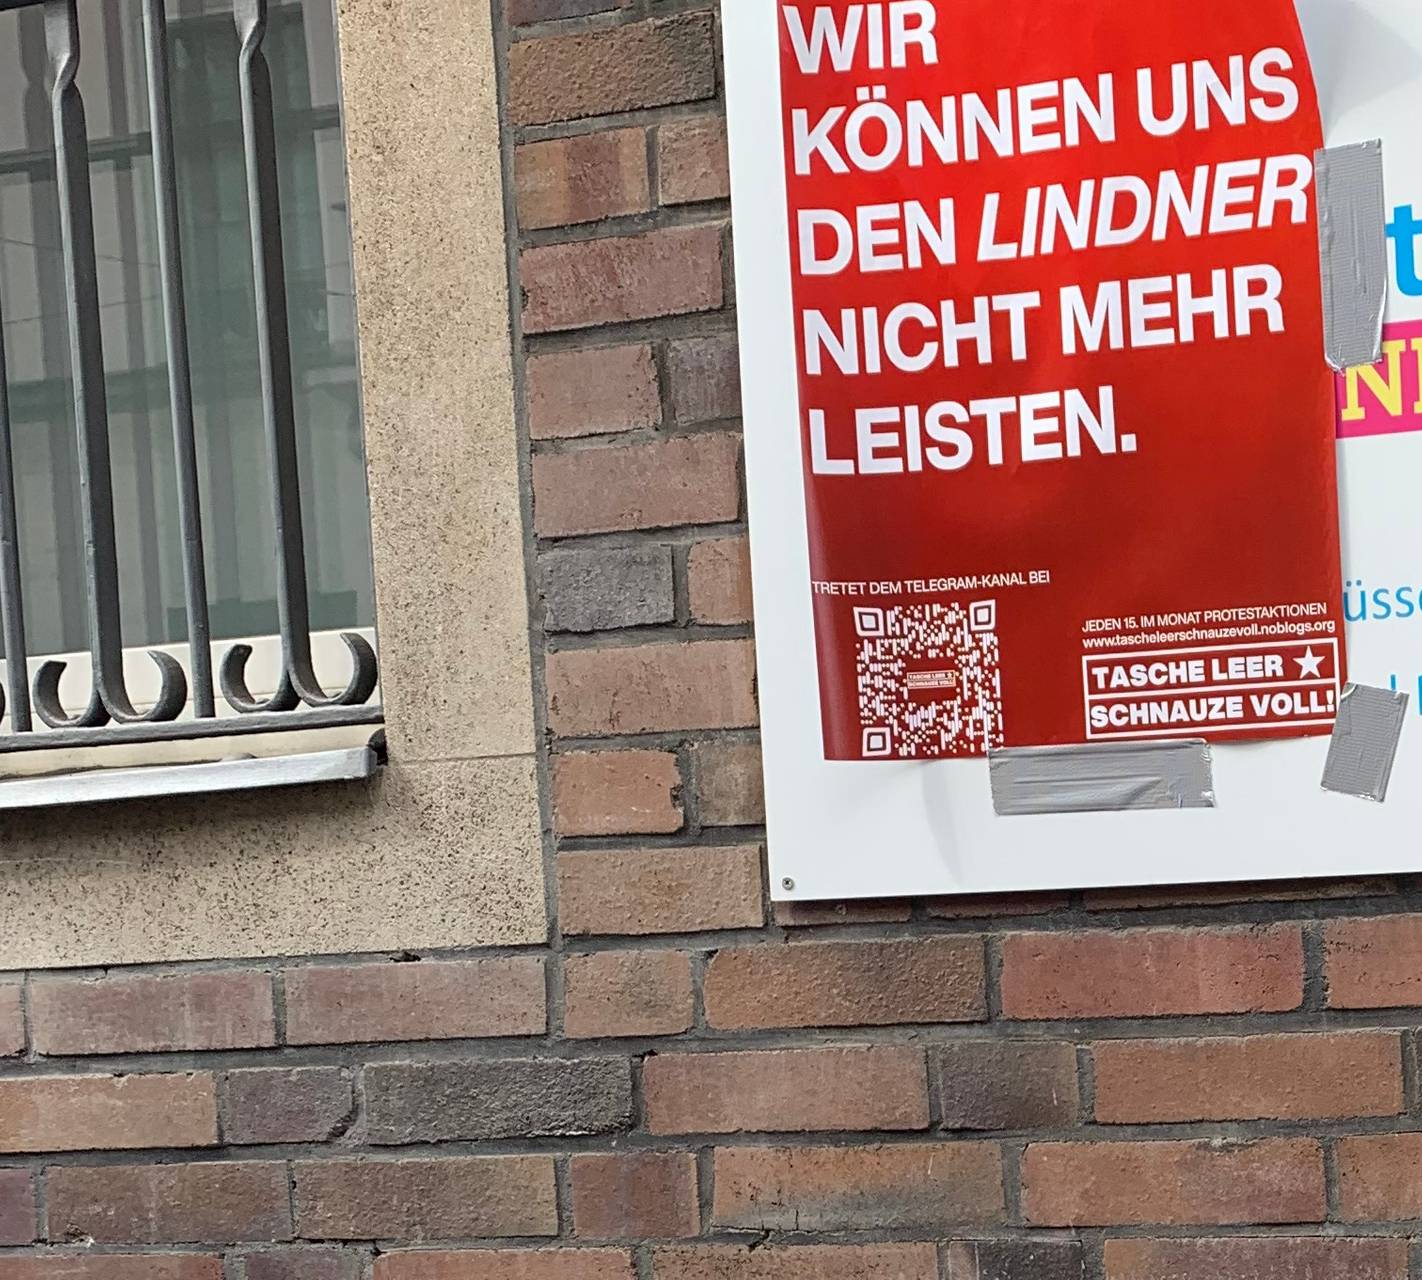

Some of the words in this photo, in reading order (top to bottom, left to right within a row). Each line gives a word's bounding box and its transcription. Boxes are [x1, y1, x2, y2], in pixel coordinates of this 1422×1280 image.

[782, 0, 938, 74] WIR
[791, 73, 1115, 175] KÖNNEN
[1136, 47, 1299, 137] UNS
[797, 198, 956, 276] DEN
[976, 154, 1314, 262] LINDNER
[803, 290, 1040, 376] NICHT
[1060, 263, 1284, 355] MEHR
[808, 385, 1137, 475] LEISTEN.
[812, 581, 866, 595] TRETET
[867, 580, 901, 594] DEM
[905, 572, 1027, 593] TELEGRAM-KANAL
[1029, 570, 1050, 584] BEI
[1082, 617, 1121, 632] JEDEN
[1123, 616, 1139, 629] 15.
[1140, 614, 1155, 628] IM
[1157, 611, 1201, 627] MONAT
[1203, 602, 1327, 623] PROTESTAKTIONEN
[1083, 620, 1335, 648] www.tascheleerschnauzevoll.noblogs.org
[1091, 660, 1205, 689] TASCHE
[1211, 654, 1283, 681] LEER
[1090, 696, 1244, 728] SCHNAUZE
[1249, 690, 1335, 717] VOLL!
